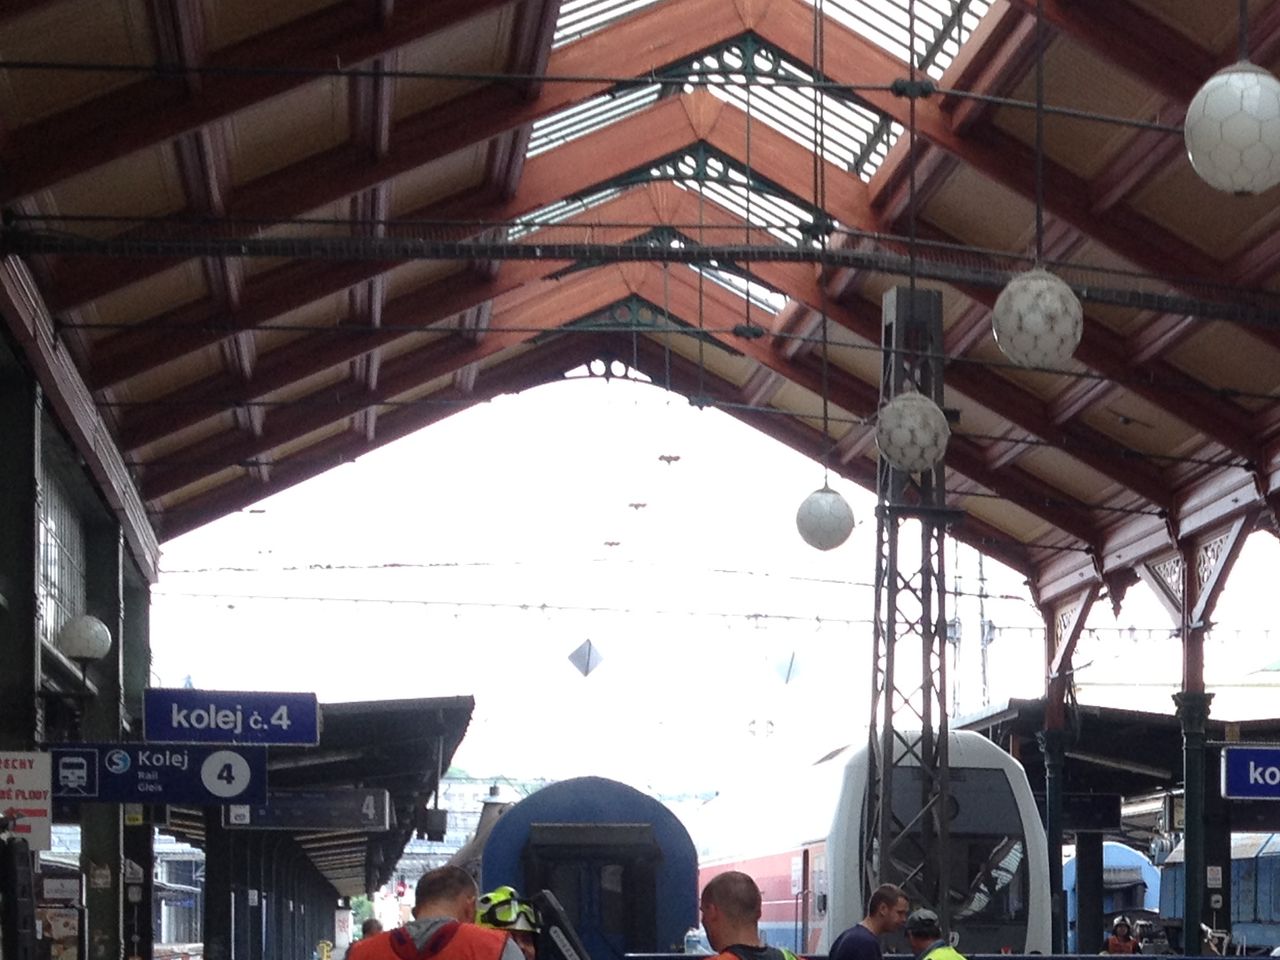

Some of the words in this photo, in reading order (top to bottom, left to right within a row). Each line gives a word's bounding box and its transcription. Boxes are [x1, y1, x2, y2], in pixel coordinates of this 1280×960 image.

[172, 703, 242, 734] kolej
[138, 750, 188, 770] Kolej
[6, 773, 15, 785] A
[217, 763, 235, 785] 4
[362, 795, 376, 820] 4
